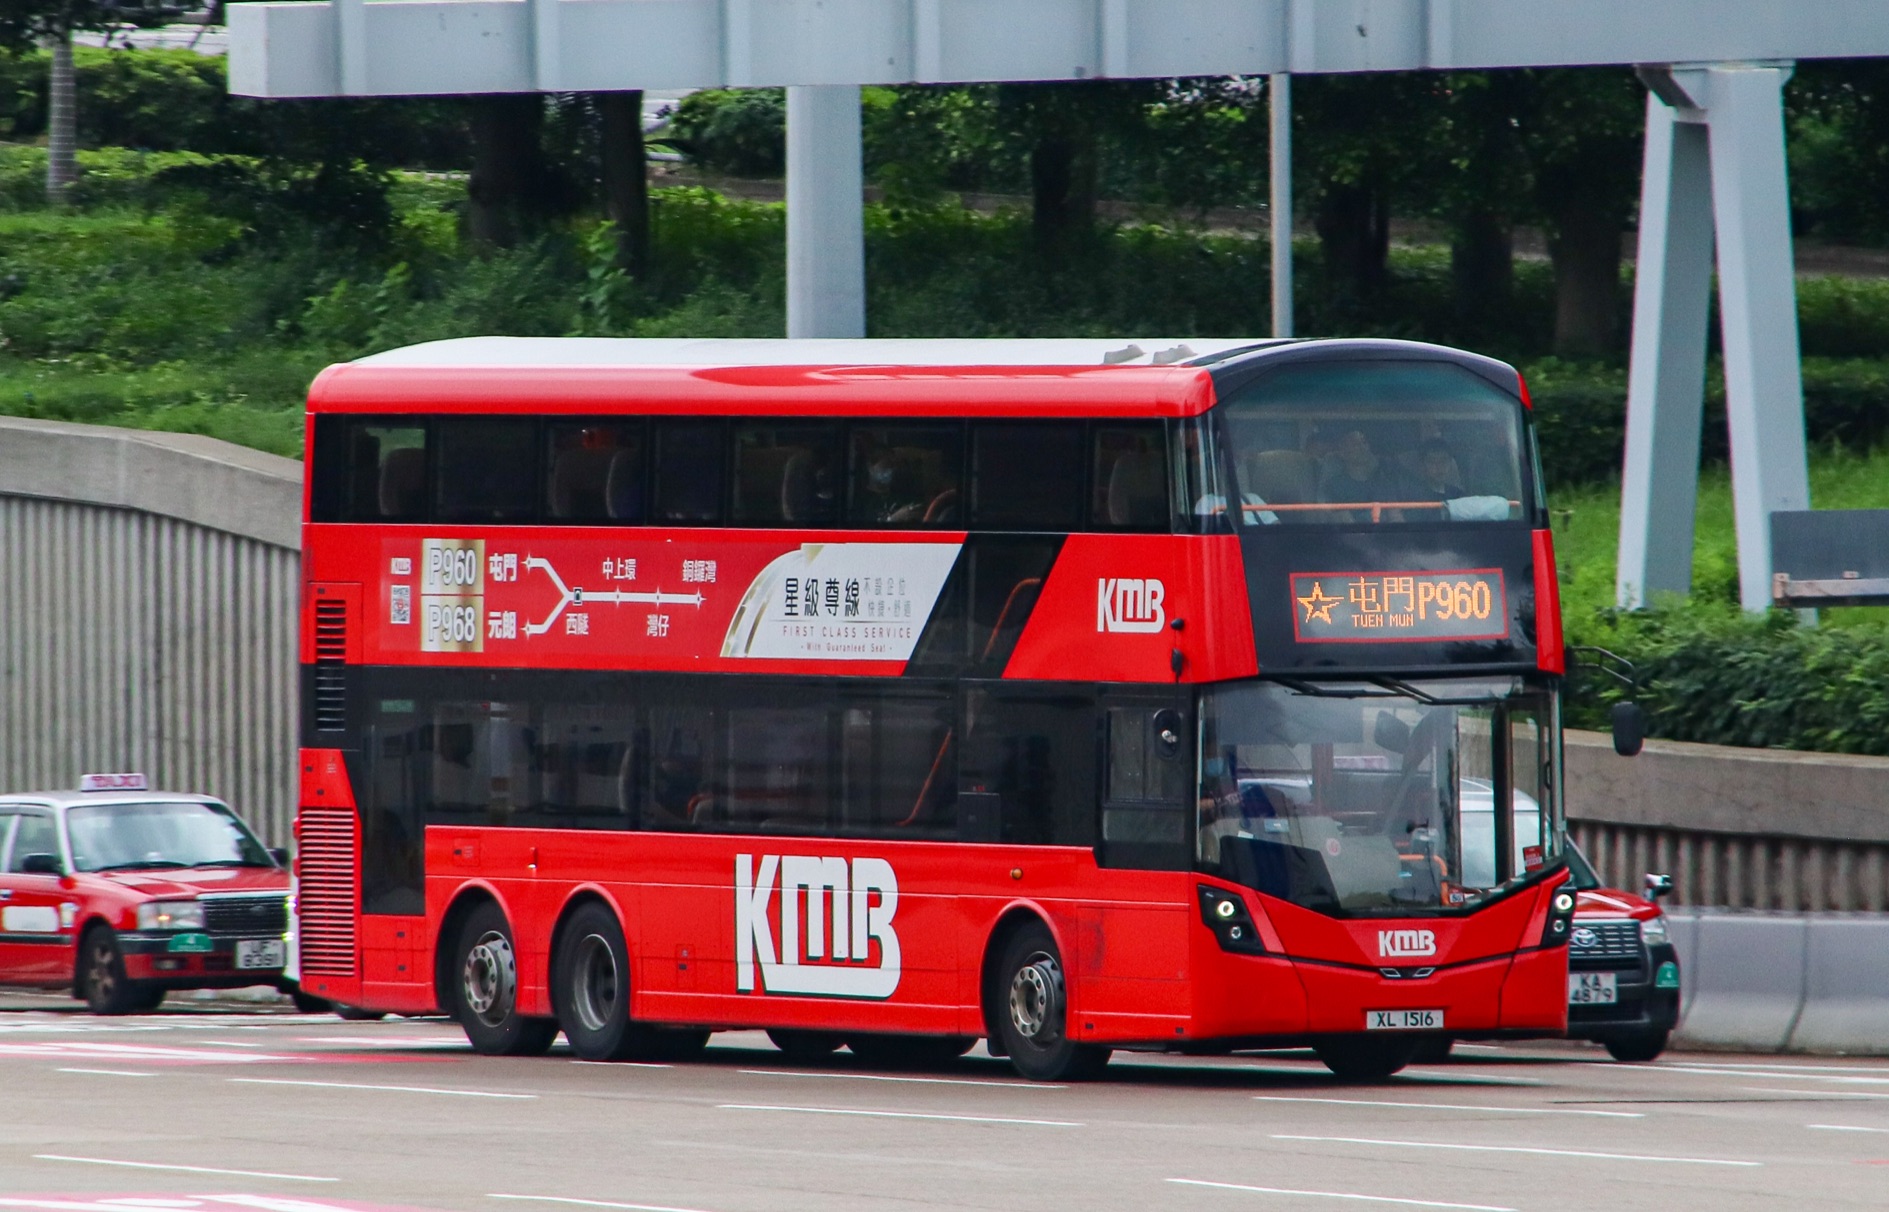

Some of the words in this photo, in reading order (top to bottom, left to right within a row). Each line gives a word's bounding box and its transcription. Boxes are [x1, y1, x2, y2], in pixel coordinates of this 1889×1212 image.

[429, 547, 476, 585] P960
[489, 553, 518, 582] 屯門
[602, 557, 636, 580] 中上環
[682, 560, 717, 583] 銅鑼灣
[784, 578, 860, 617] 星級尊線
[1097, 578, 1165, 633] KMB
[1349, 576, 1415, 614] 屯門
[1418, 581, 1491, 620] P960
[428, 605, 475, 642] P968
[488, 612, 517, 639] 元朗
[566, 613, 589, 635] 西隧
[646, 614, 669, 637] 灣仔
[1352, 614, 1384, 627] TUEN
[1390, 613, 1414, 627] MUN
[783, 626, 815, 637] FIRST
[822, 626, 857, 638] CLASS
[864, 627, 911, 639] SERVICE
[806, 643, 821, 652] With
[735, 853, 901, 999] KMB
[1378, 930, 1436, 956] KMB
[1580, 974, 1602, 989] KA
[1571, 988, 1613, 1003] 4879
[1377, 1012, 1397, 1027] XL
[1404, 1012, 1434, 1027] 1516
